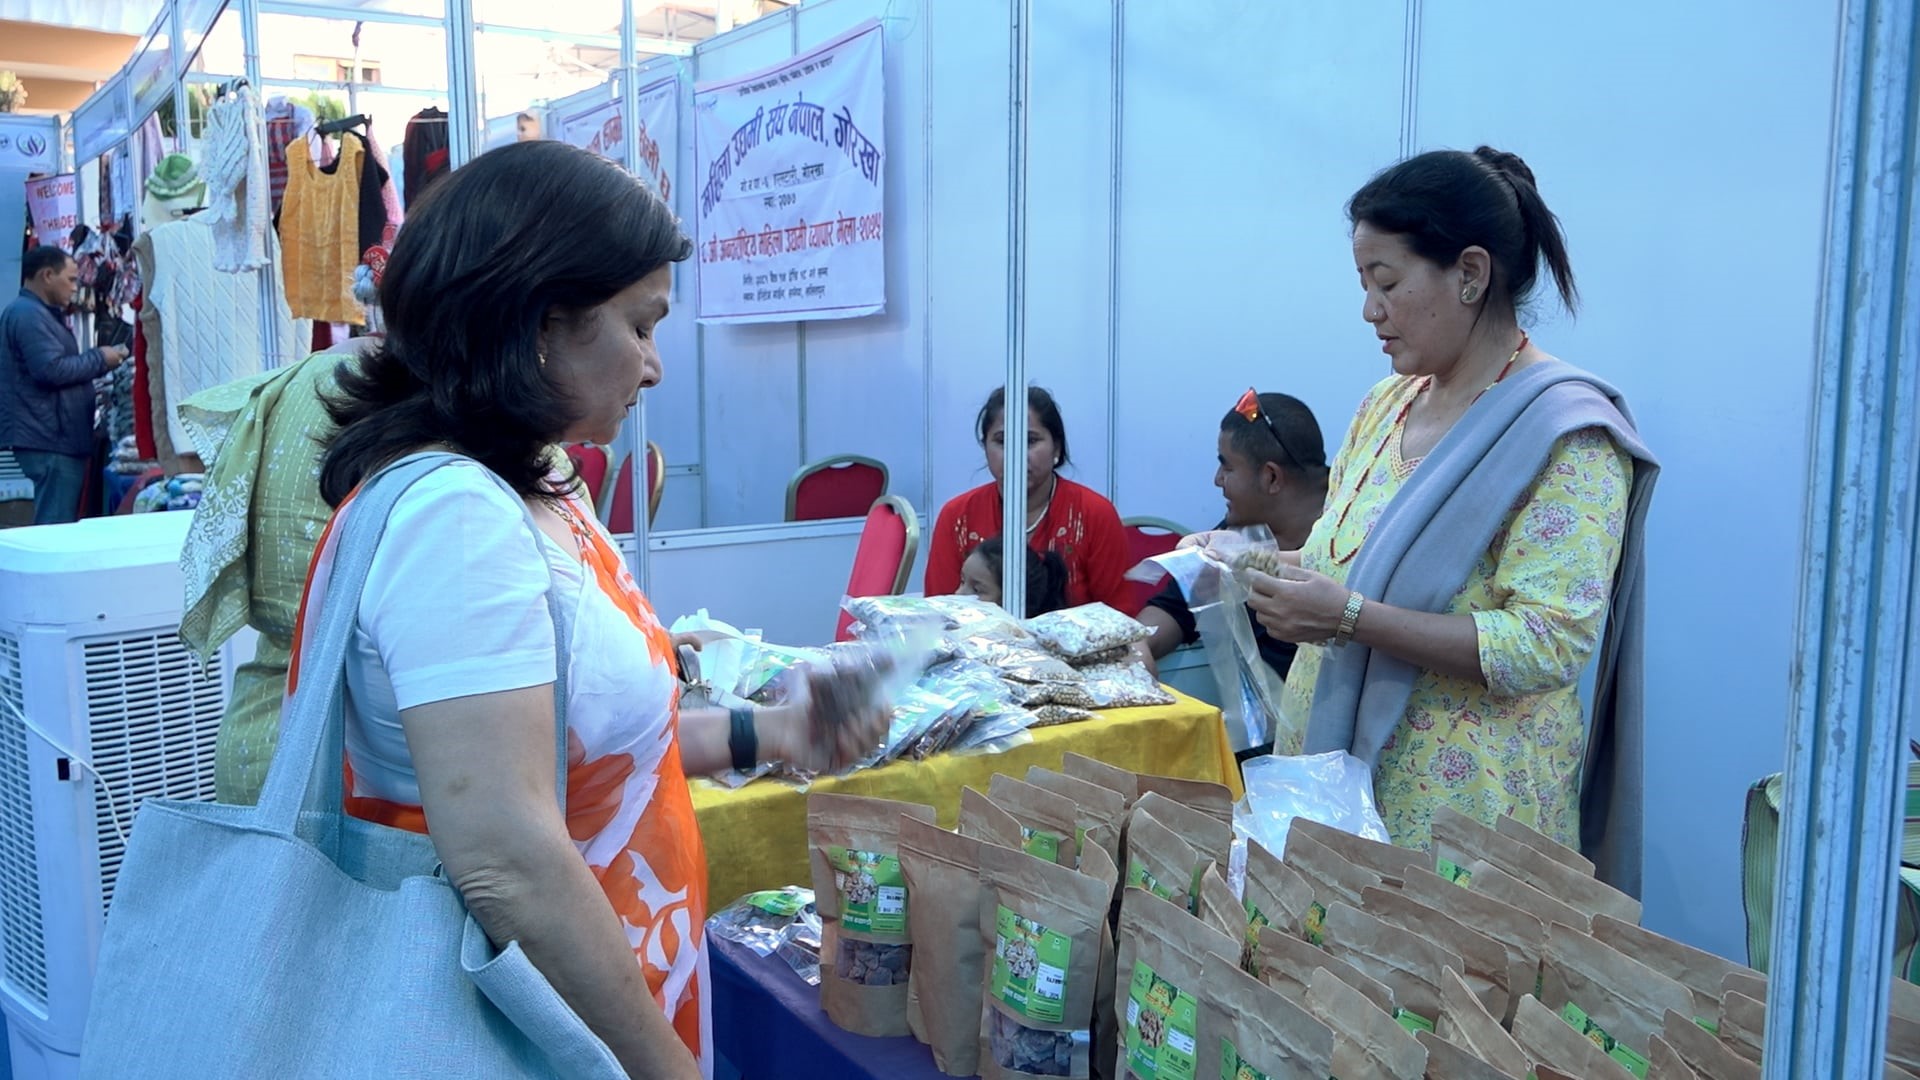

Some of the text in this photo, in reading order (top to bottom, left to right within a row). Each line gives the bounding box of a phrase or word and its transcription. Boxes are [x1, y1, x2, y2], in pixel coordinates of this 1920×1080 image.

[765, 100, 790, 142] संघ
[833, 105, 881, 187] गोरखा
[36, 182, 75, 199] WELCOME
